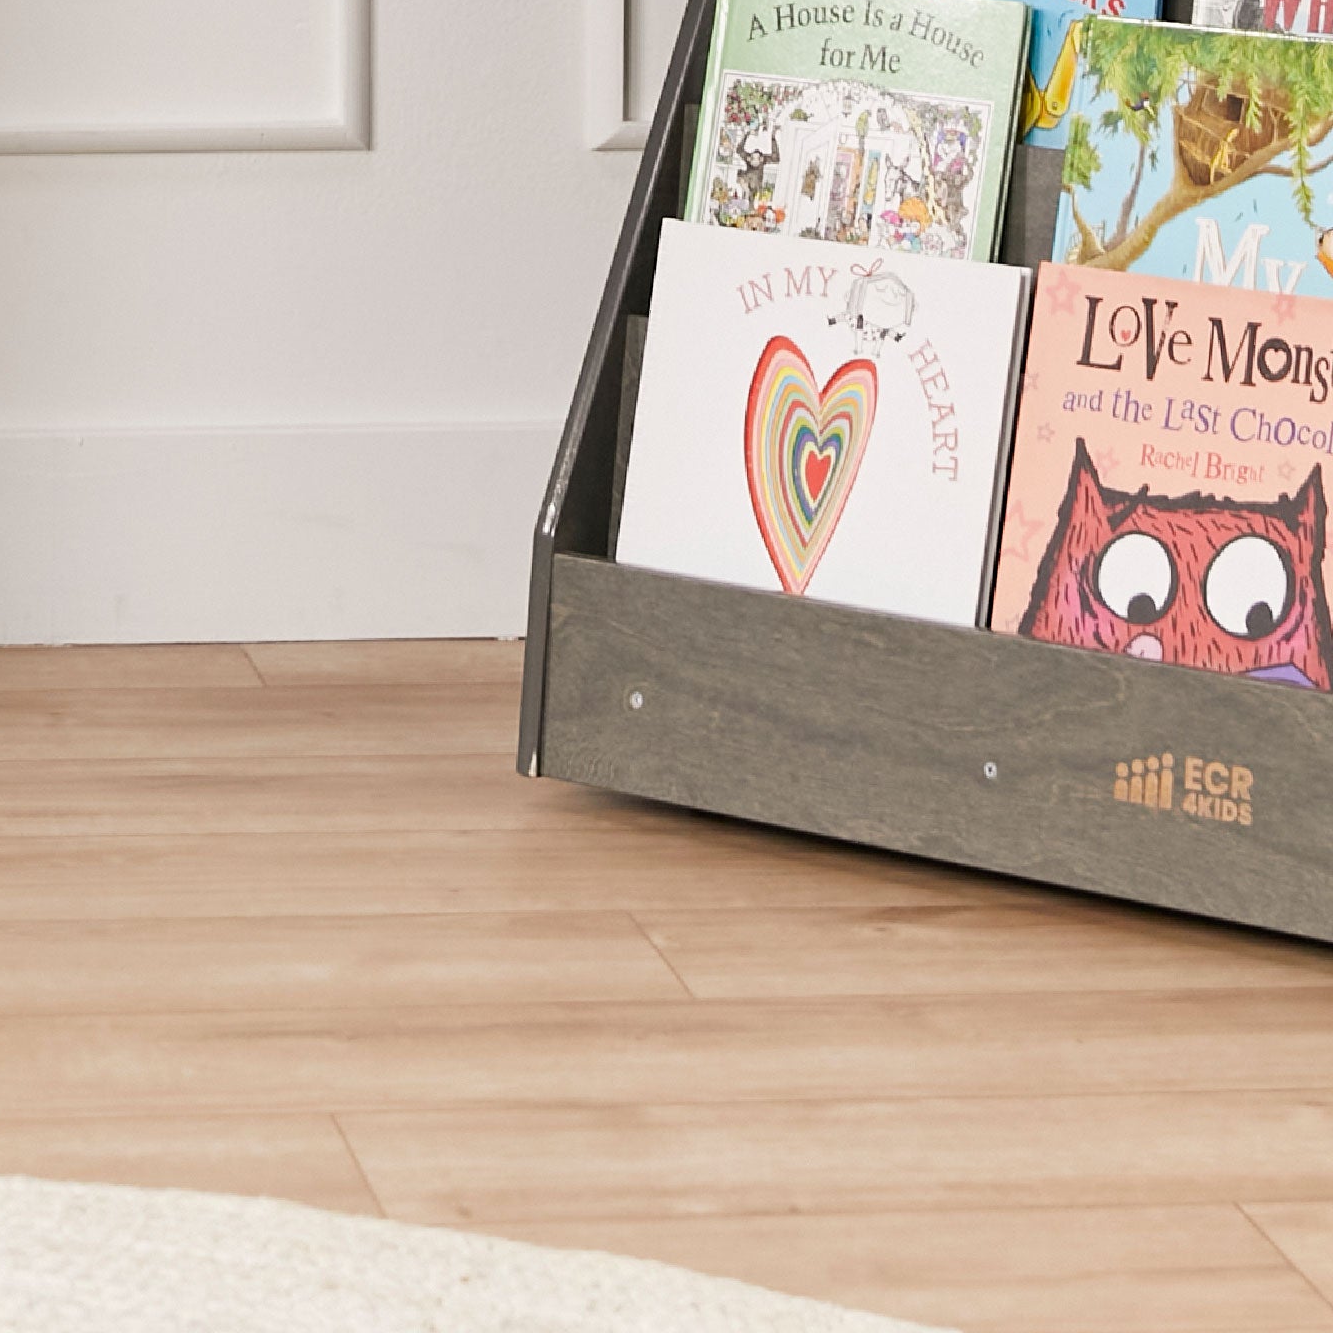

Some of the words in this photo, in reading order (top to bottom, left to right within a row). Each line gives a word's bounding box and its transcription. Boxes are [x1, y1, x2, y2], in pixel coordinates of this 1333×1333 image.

[747, 13, 769, 42] A
[773, 2, 856, 32] House
[863, 0, 884, 27] Is
[889, 13, 903, 32] a
[908, 8, 985, 69] House
[819, 37, 856, 66] for
[860, 43, 902, 74] Me
[736, 273, 775, 315] IN
[784, 265, 839, 298] MY
[907, 337, 959, 482] HEART
[1201, 316, 1333, 404] Mons
[1062, 389, 1104, 413] and
[1112, 387, 1153, 424] the
[1140, 443, 1200, 479] Rachel
[1204, 451, 1266, 485] Bright
[1185, 755, 1254, 801] ECR
[1181, 793, 1254, 826] 4KIDS
